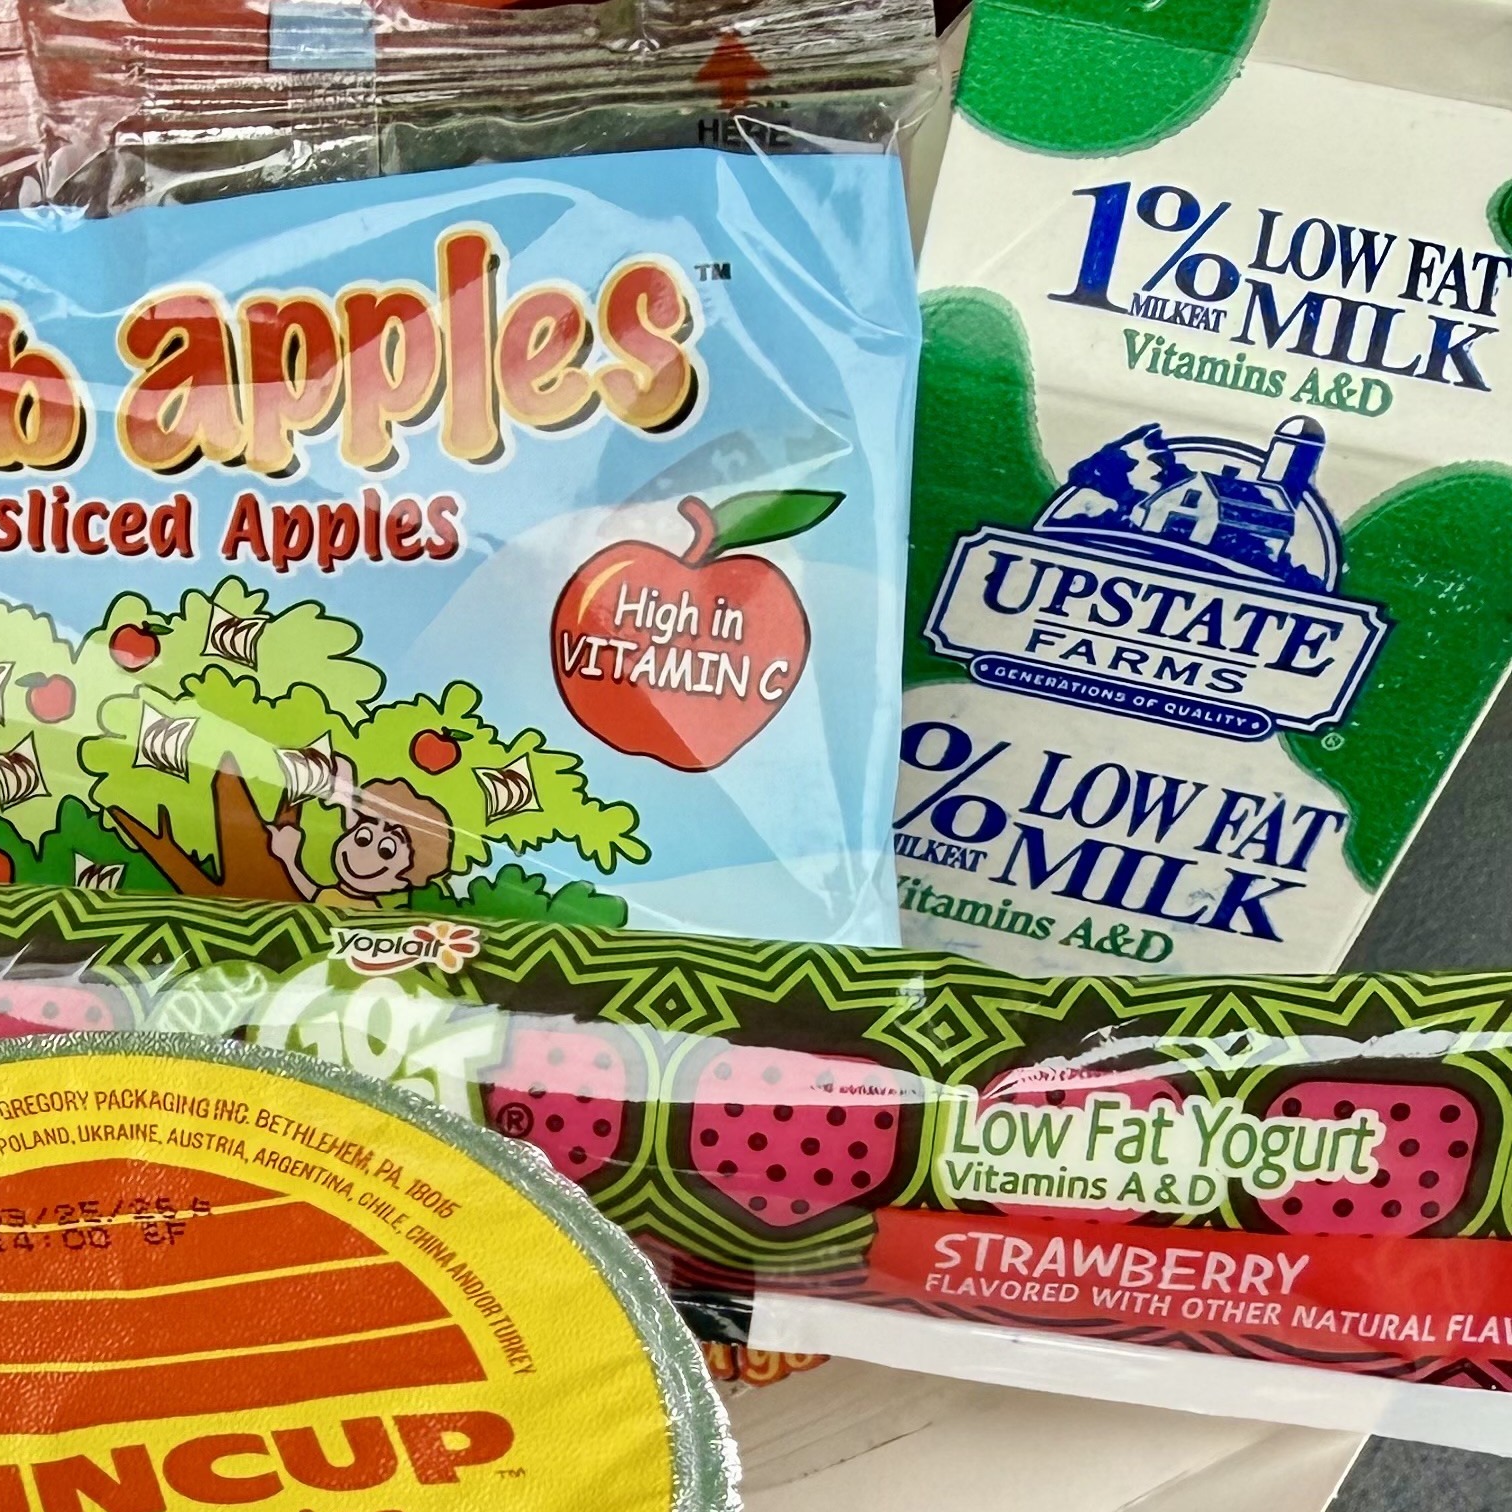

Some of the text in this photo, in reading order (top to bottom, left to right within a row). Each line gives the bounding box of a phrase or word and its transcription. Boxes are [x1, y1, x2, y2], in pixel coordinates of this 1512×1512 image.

[1048, 181, 1241, 314] 1%
[1247, 208, 1512, 317] LOW FAT
[120, 231, 700, 473] apples
[1128, 291, 1228, 334] MILKFAT
[1229, 277, 1500, 392] MILK
[1122, 328, 1395, 419] Vitamins A&D
[221, 487, 460, 572] Apples
[614, 583, 743, 645] High in
[983, 550, 1344, 678] UPSTATE
[560, 631, 789, 701] VITAMIN C
[994, 666, 1248, 728] GENERATIONS OF QUALITY
[1024, 628, 1248, 694] FARMS
[1018, 750, 1348, 873] LOW FAT
[988, 822, 1308, 943] MILK
[1058, 915, 1175, 964] A&D
[93, 1088, 210, 1119] PACKAGING
[212, 1098, 251, 1126] INC.
[403, 1177, 464, 1220] 18015
[945, 1159, 1108, 1201] Vitamins
[952, 1098, 1377, 1190] Low Fat Yogurt
[252, 1146, 354, 1202] ARGENTINA,
[357, 1191, 410, 1235] CHILE,
[404, 1223, 457, 1268] CHINA
[445, 1262, 504, 1319] AND/OR
[488, 1314, 538, 1376] TURKEY
[934, 1231, 1310, 1296] STRAWBERRY
[924, 1274, 1080, 1303] FLAVORED
[1091, 1286, 1172, 1317] WITH
[1180, 1297, 1282, 1326] OTHER
[1290, 1305, 1436, 1343] NATURAL
